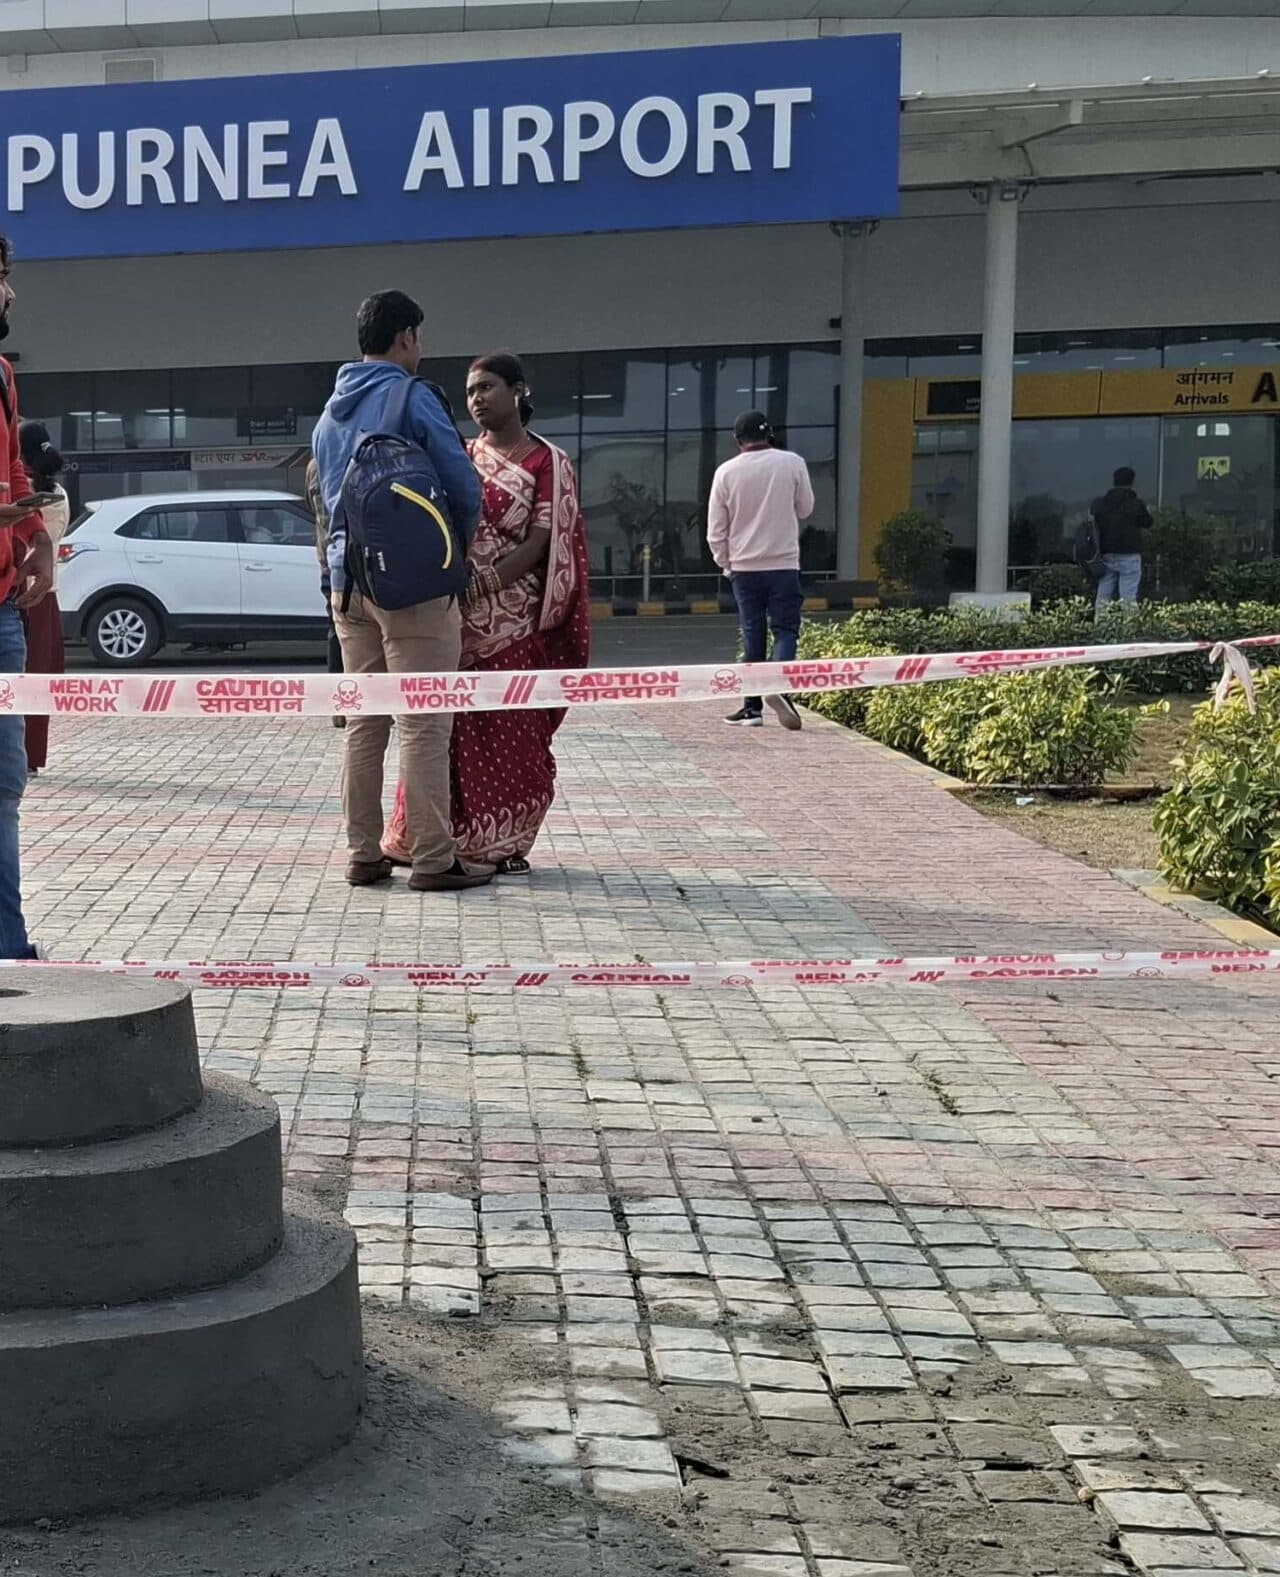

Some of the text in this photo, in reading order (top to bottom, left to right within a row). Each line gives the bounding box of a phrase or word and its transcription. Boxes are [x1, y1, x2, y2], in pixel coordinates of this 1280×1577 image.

[7, 87, 813, 211] PURNEA AIRPORT
[1176, 371, 1234, 385] आगमन
[1174, 392, 1230, 406] Arrivals
[49, 679, 124, 694] MEN AT
[196, 678, 305, 697] CAUTION
[400, 676, 481, 693] MEN AT
[559, 670, 679, 688] CAUTION
[789, 672, 866, 689] WORK
[405, 692, 476, 710] WORK
[561, 685, 680, 703] सावधान
[54, 696, 119, 713] WORK
[198, 697, 306, 714] सावधान
